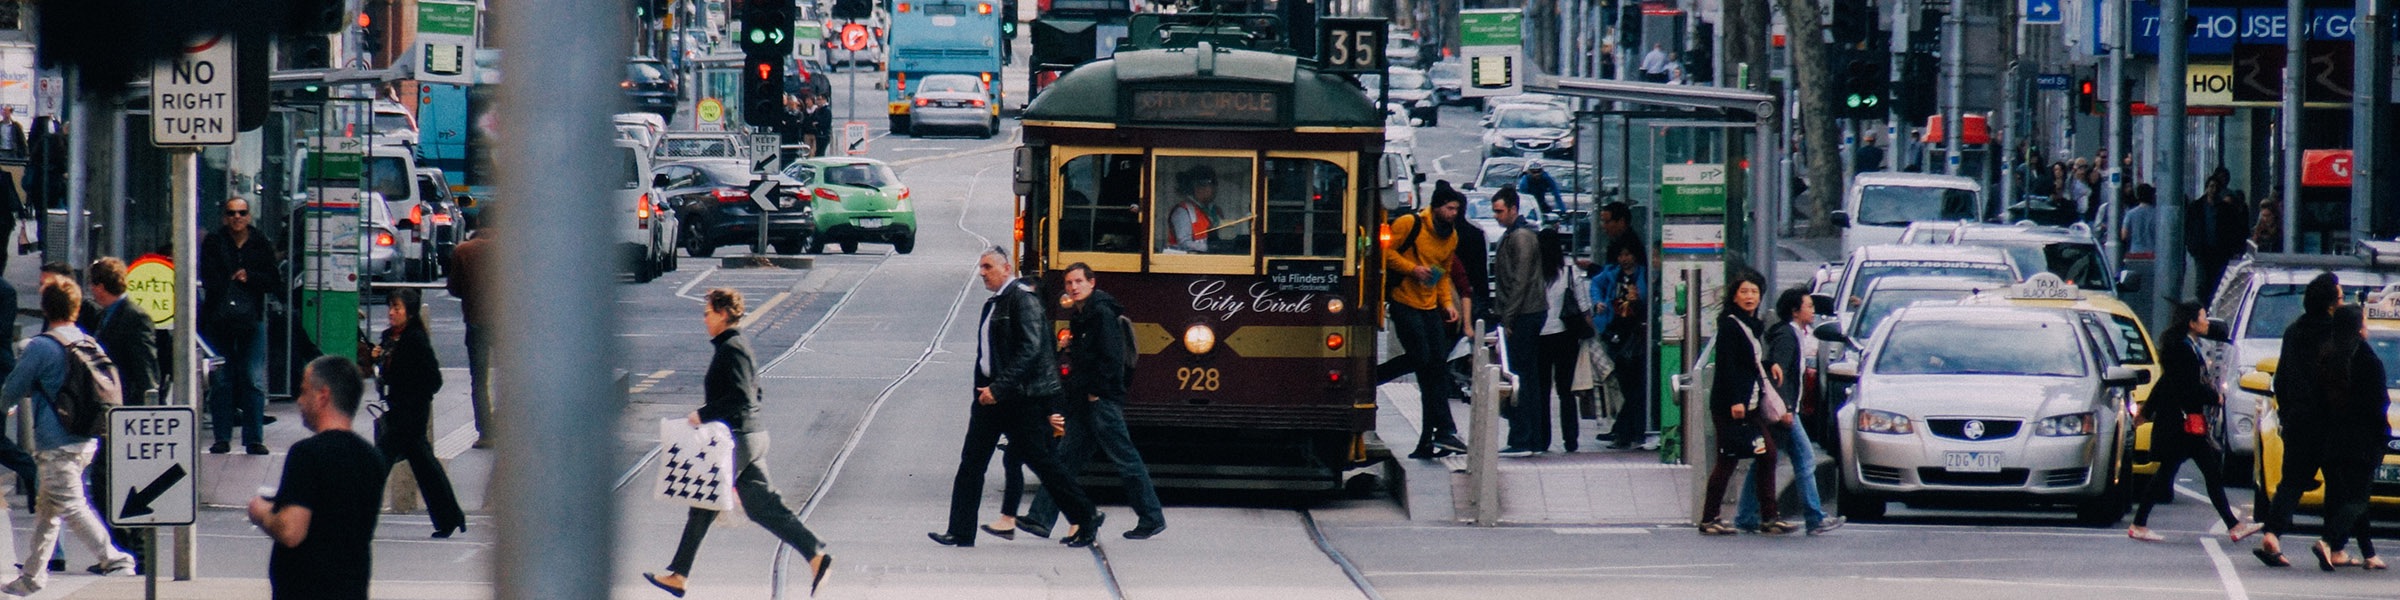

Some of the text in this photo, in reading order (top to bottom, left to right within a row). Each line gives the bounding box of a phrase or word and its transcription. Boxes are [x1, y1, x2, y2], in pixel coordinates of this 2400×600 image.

[1330, 30, 1372, 65] 35
[172, 60, 215, 84] NO
[162, 93, 227, 109] RIGHT
[1143, 91, 1272, 111] CITY CIRCLE
[164, 117, 222, 134] TURN
[1715, 230, 1722, 239] 4
[1272, 273, 1339, 284] via Flinders St
[2036, 280, 2060, 289] TAXI
[1188, 280, 1316, 321] City Circle
[2023, 288, 2068, 298] BLACK CABS
[1176, 367, 1220, 391] 928
[125, 418, 180, 436] KEEP
[127, 443, 178, 460] LEFT
